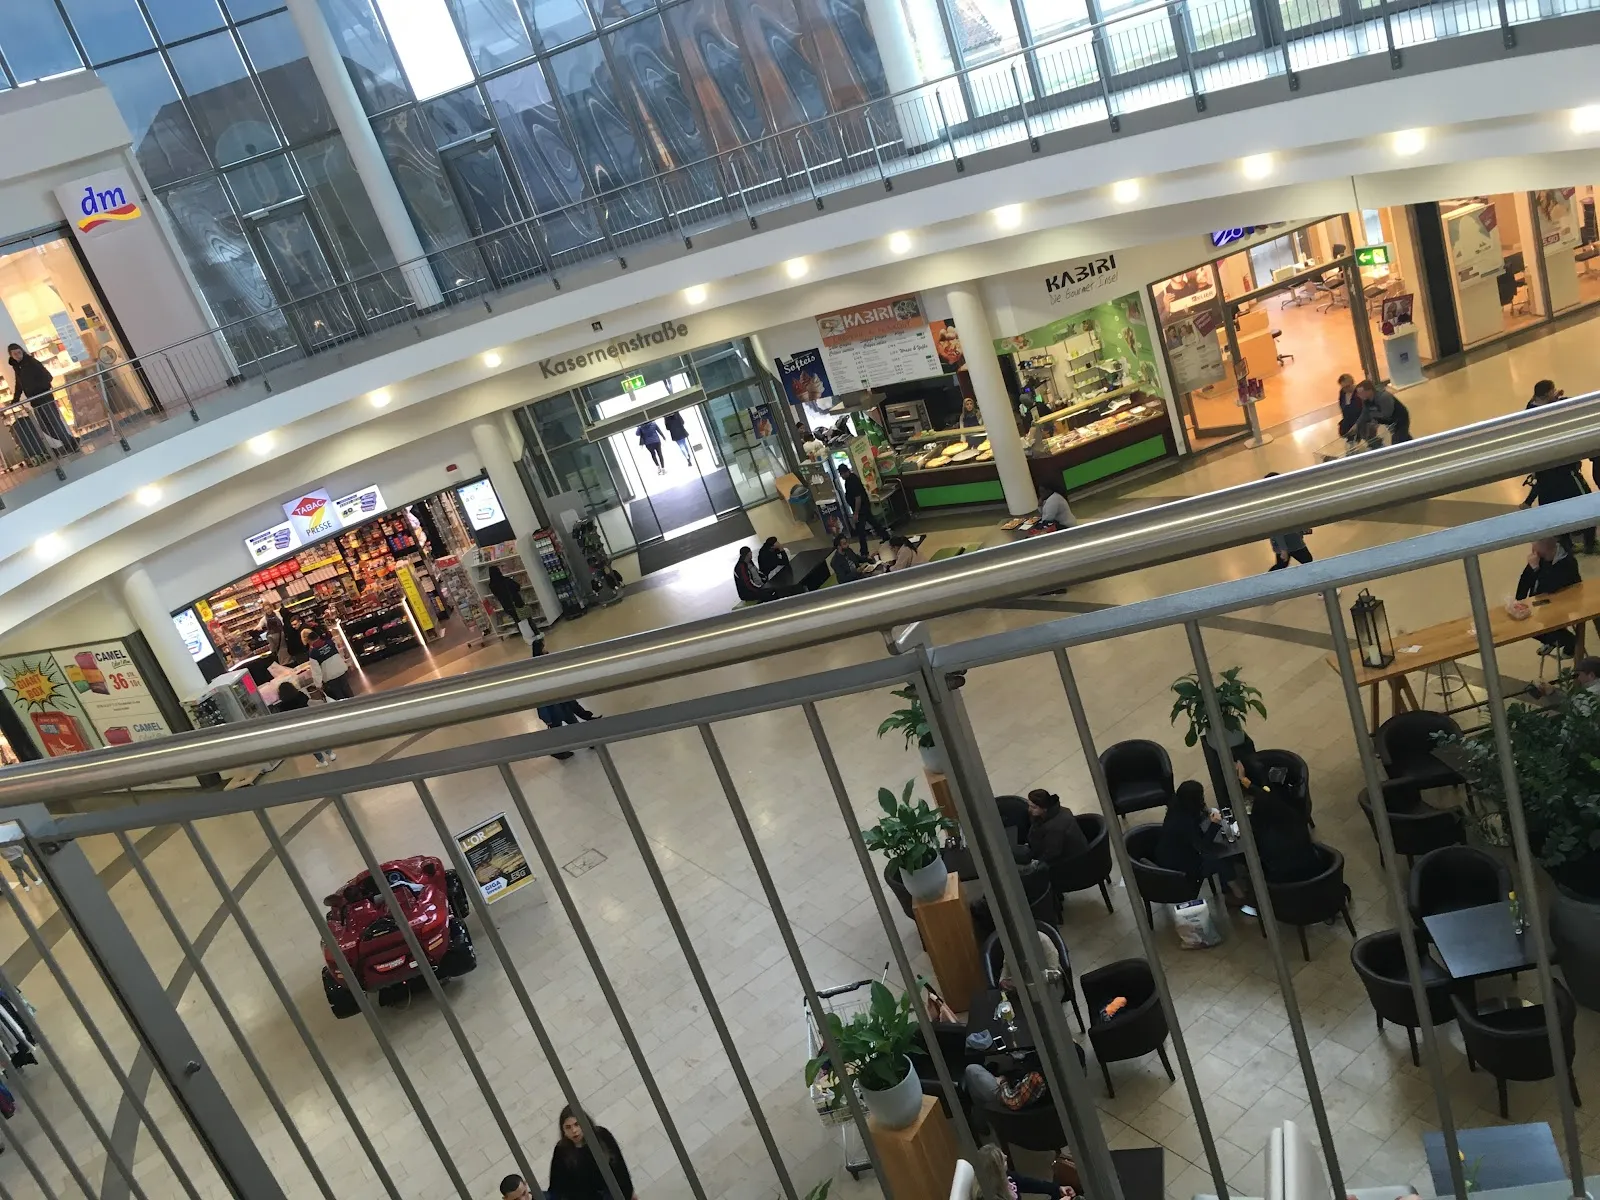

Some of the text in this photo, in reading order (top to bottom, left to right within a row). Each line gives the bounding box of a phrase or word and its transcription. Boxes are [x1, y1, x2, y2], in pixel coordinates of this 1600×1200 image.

[81, 186, 127, 216] dm
[1045, 254, 1117, 293] KABIRI
[1049, 270, 1119, 306] Die Gourmet Insel
[842, 305, 895, 329] KABIRI
[538, 320, 689, 379] Kasernenstraße
[783, 355, 816, 374] Softeis
[295, 499, 324, 516] TABAC
[305, 520, 333, 537] PRESSE
[95, 649, 127, 662] CAMEL
[16, 674, 42, 690] GIANT
[109, 673, 129, 690] 36
[27, 685, 45, 699] BOX
[133, 722, 164, 733] CAMEL
[462, 831, 487, 850] L'OR
[484, 880, 502, 891] GIGA
